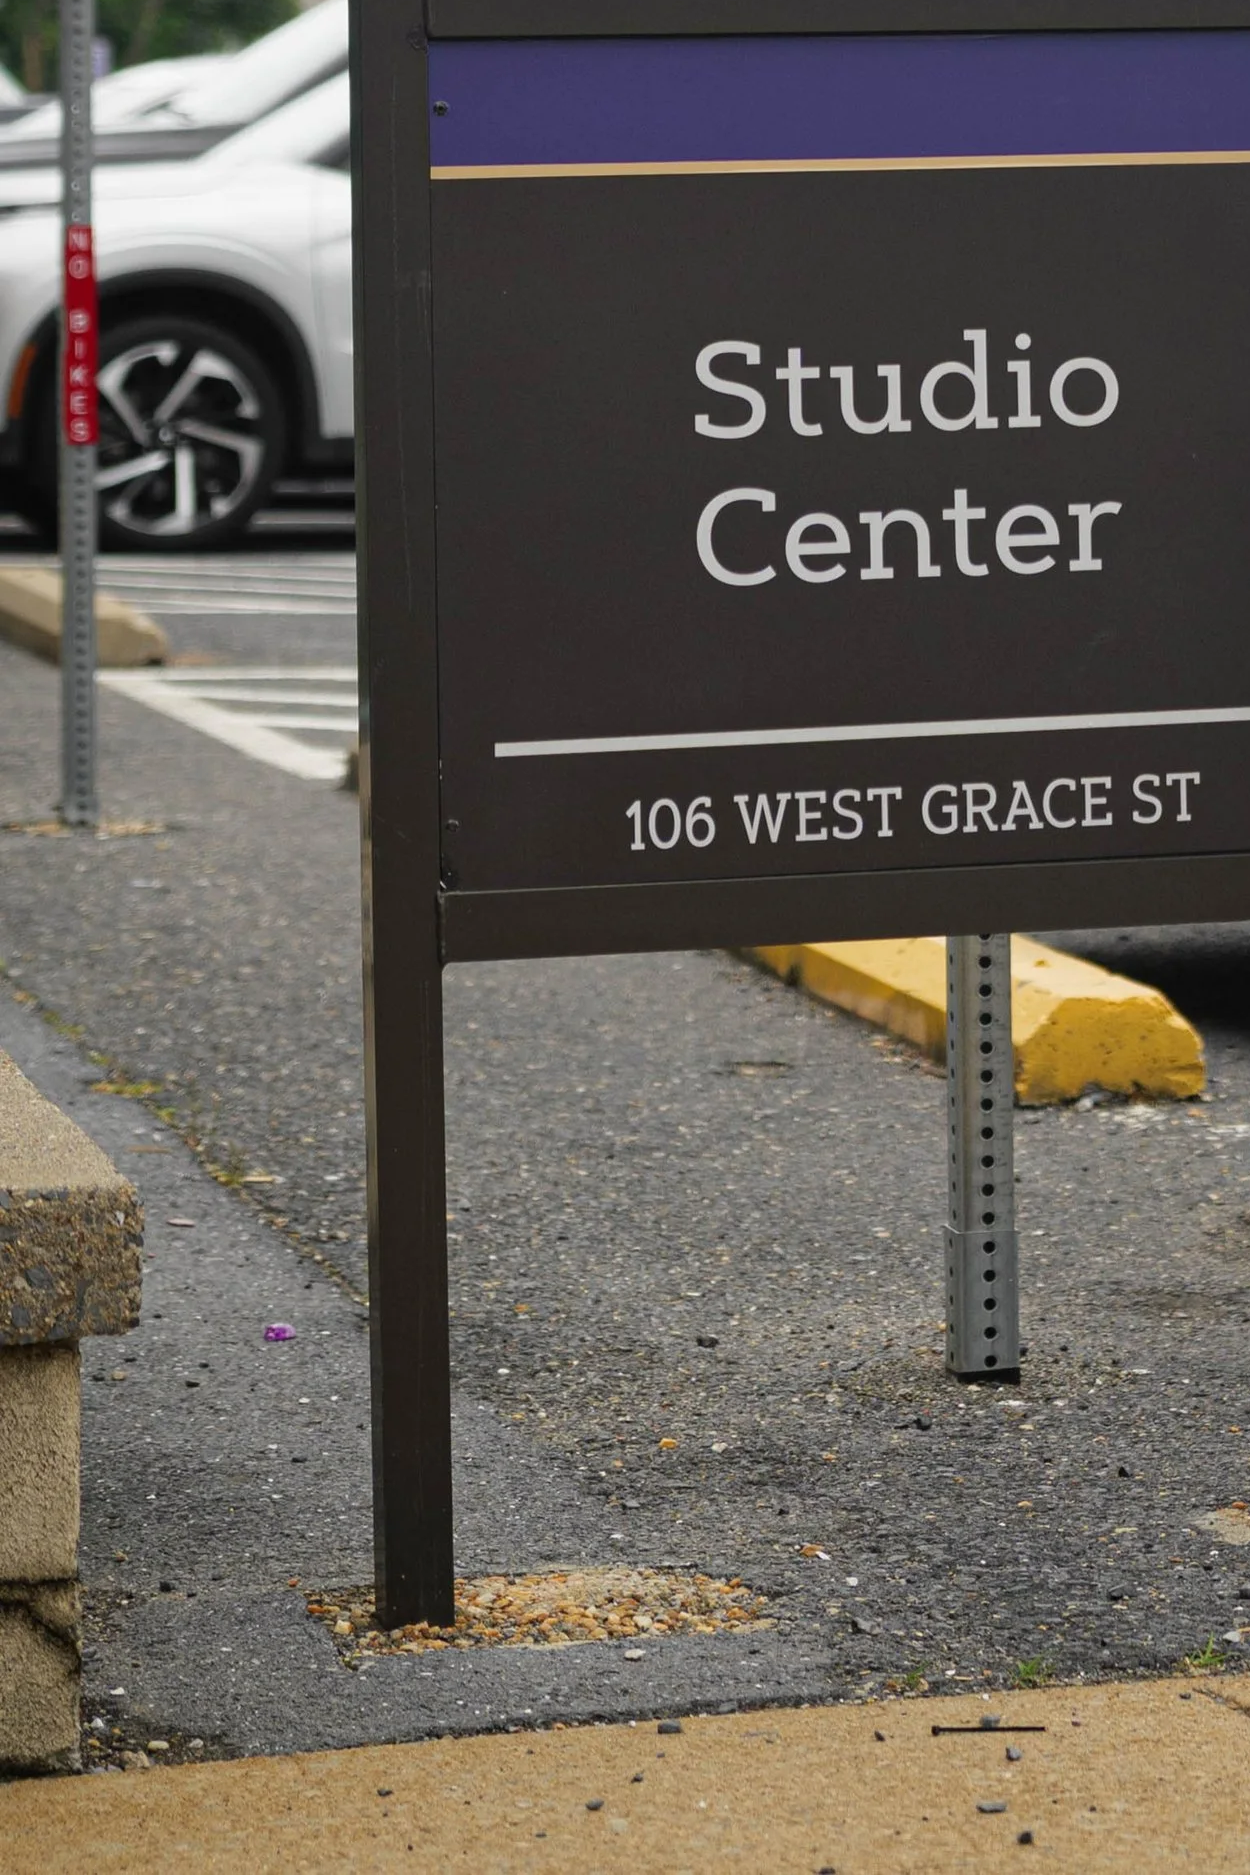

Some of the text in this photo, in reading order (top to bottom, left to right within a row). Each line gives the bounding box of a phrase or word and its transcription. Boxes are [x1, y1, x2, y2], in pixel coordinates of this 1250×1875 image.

[69, 309, 90, 442] BIKES
[694, 329, 1119, 439] Studio
[696, 487, 1122, 586] Center
[625, 771, 1201, 850] 106 WEST GRACE ST
